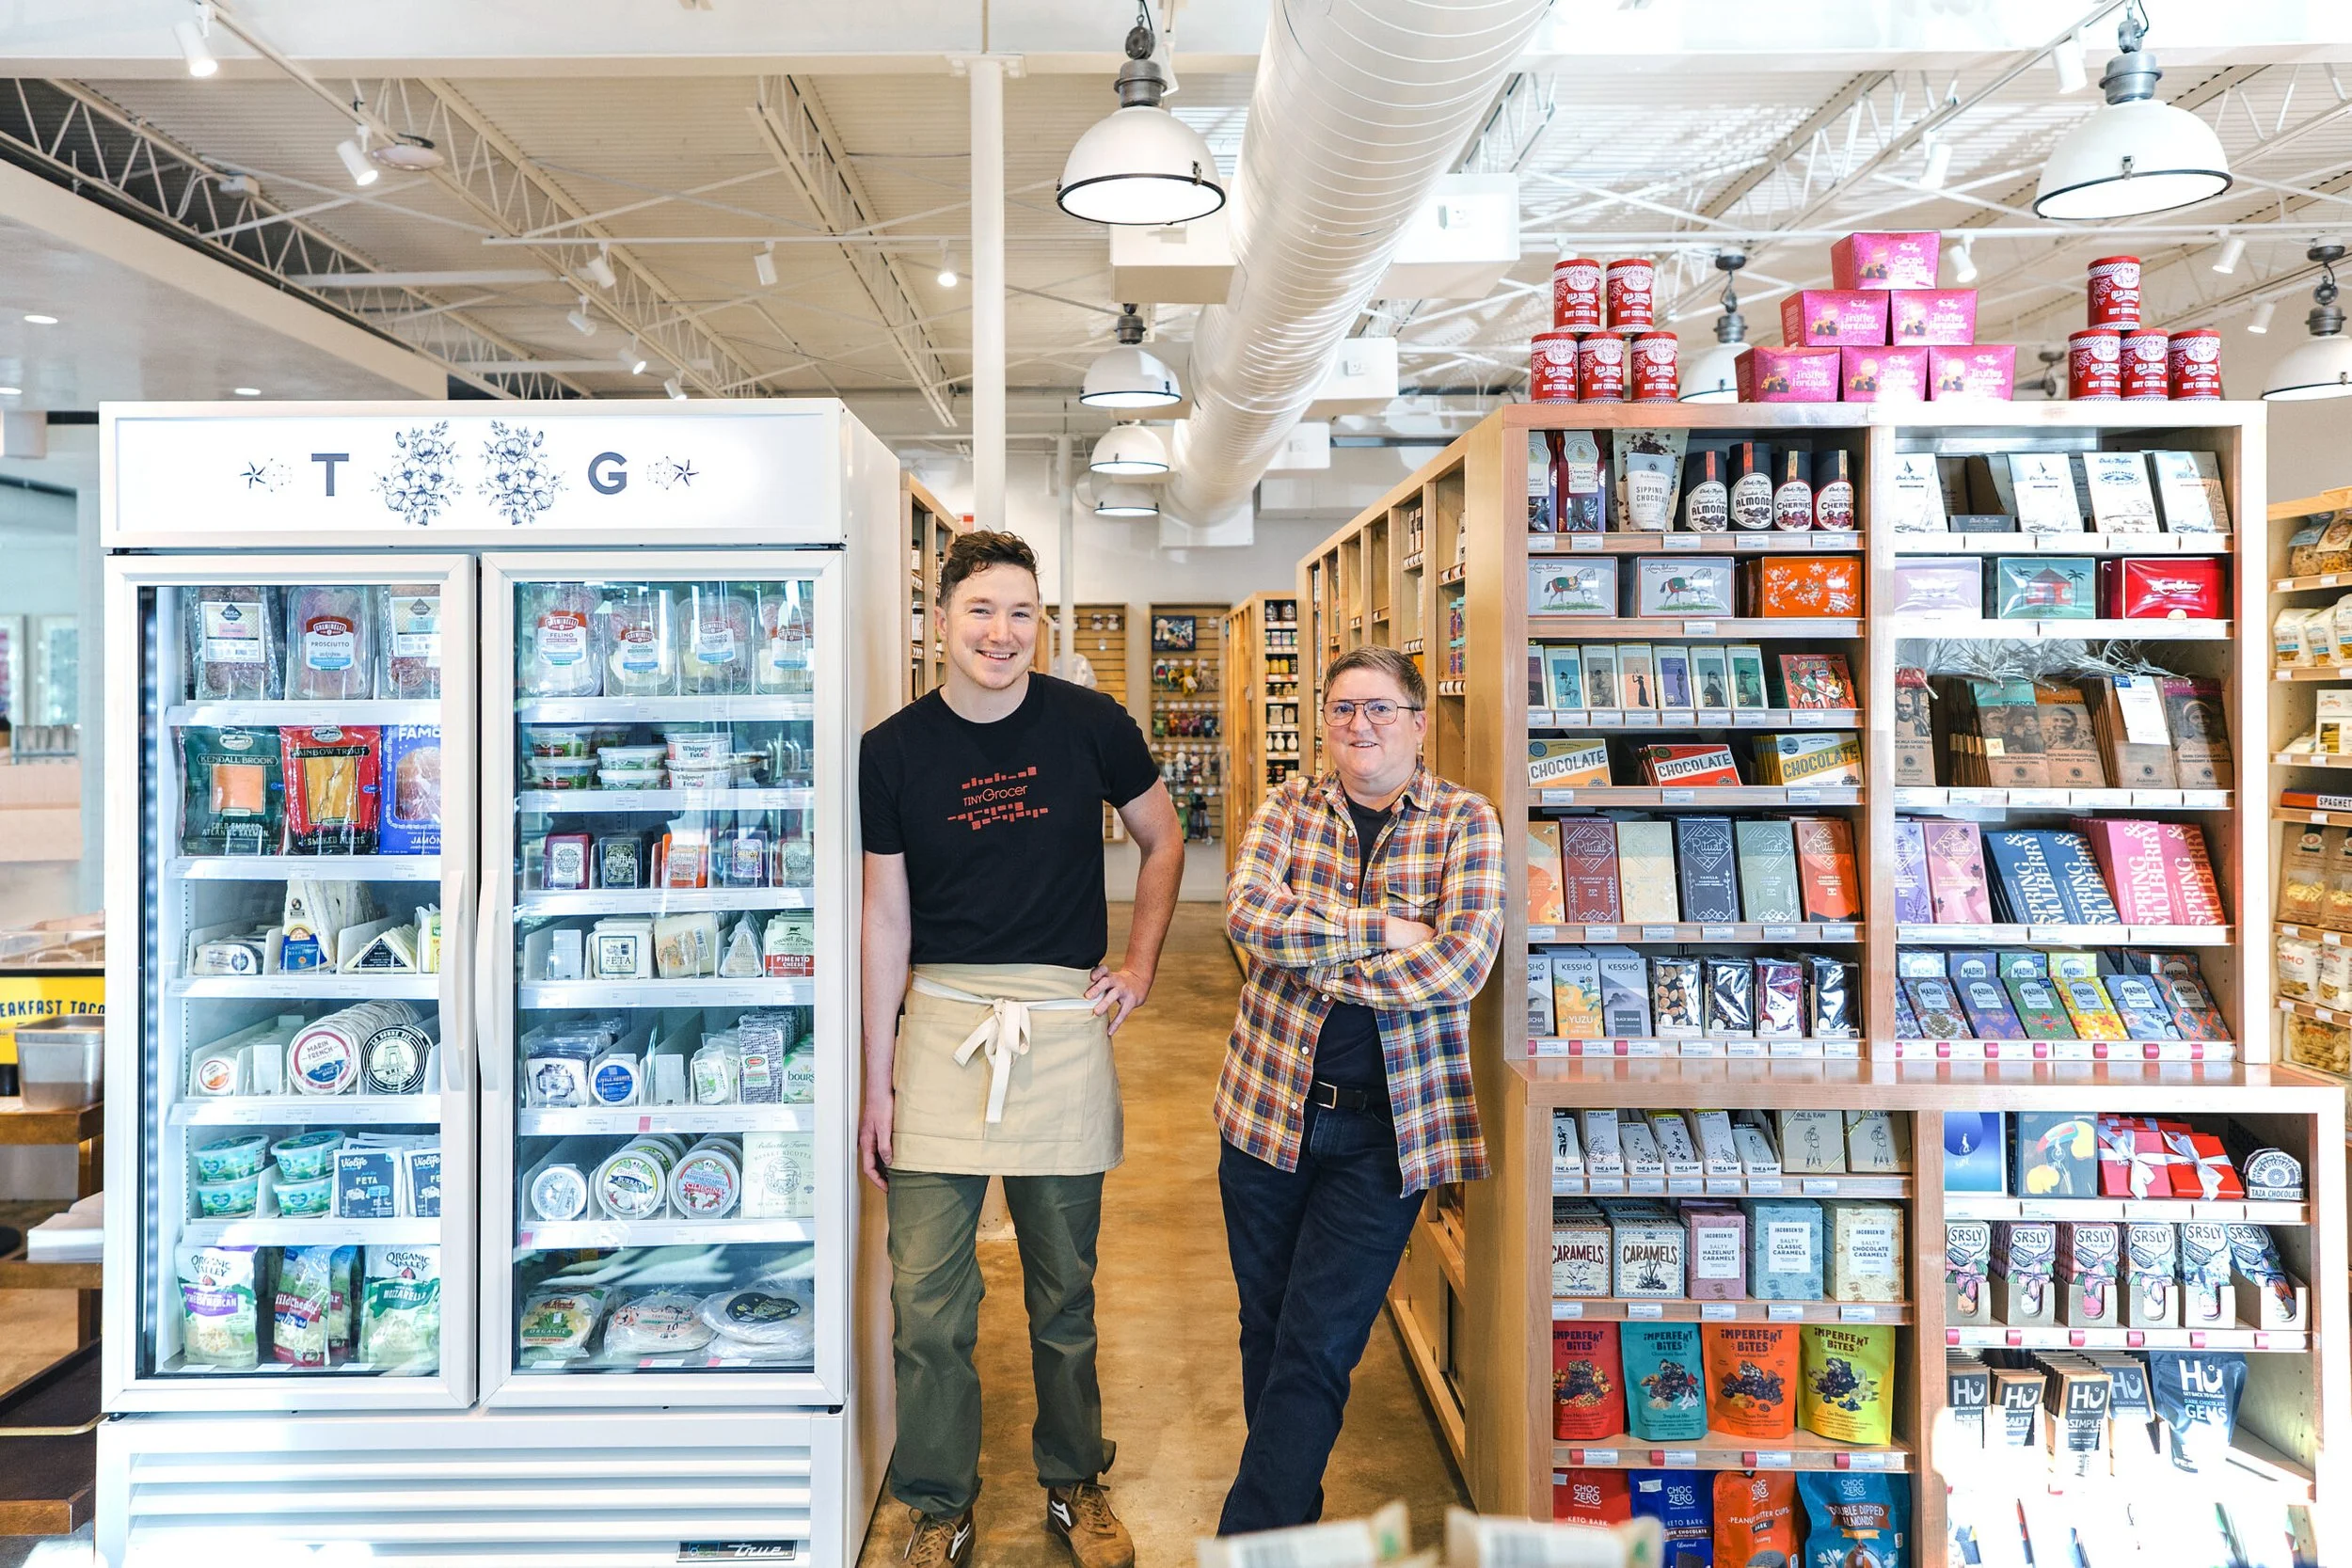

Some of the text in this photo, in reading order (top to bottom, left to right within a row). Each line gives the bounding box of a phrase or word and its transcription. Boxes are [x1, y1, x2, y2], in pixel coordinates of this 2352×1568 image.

[311, 451, 628, 497] T G
[200, 755, 274, 765] KENDALL BROOK
[1530, 750, 1606, 780] CHOCOLATE
[1658, 752, 1732, 778] CHOCOLATE
[1783, 744, 1859, 779] CHOCOLATE
[2014, 862, 2051, 925] SPRING
[2064, 862, 2103, 925] SPRING
[2128, 855, 2154, 925] SPRING
[2174, 857, 2207, 925] SPRING
[1963, 967, 1984, 977] MADHU
[2013, 967, 2035, 977] MADHU
[2063, 967, 2084, 977] MADHU
[1920, 988, 1943, 998] MADHU
[1972, 988, 1994, 998] MADHU
[2022, 988, 2044, 998] MADHU
[2072, 988, 2096, 998] MADHU
[2122, 987, 2146, 996] MADHU
[2173, 986, 2198, 996] MADHU
[1569, 1015, 1593, 1024] YUZU
[307, 1040, 329, 1053] MARIN
[308, 1046, 334, 1060] FRENCH
[341, 1157, 368, 1170] Violife
[356, 1176, 378, 1185] FETA
[2250, 1189, 2303, 1198] TAZA CHOCOLATE
[1950, 1229, 1982, 1242] SRSLY
[2014, 1230, 2047, 1243] SRSLY
[2077, 1230, 2110, 1243] SRSLY
[2134, 1229, 2168, 1243] SRSLY
[2187, 1226, 2221, 1239] SRSLY
[2229, 1227, 2265, 1240] SRSLY
[386, 1251, 431, 1267] ORGANIC
[1552, 1244, 1604, 1264] CARAMELS
[1623, 1244, 1677, 1265] CARAMELS
[2185, 1404, 2228, 1422] GEMS
[2068, 1418, 2101, 1429] SIMPLE
[1841, 1479, 1864, 1487] CHOC
[1573, 1484, 1600, 1494] CHOC
[1667, 1486, 1692, 1495] CHOC
[1843, 1486, 1867, 1496] ZERO
[1573, 1494, 1601, 1505] ZERO
[1668, 1494, 1695, 1505] ZERO
[1774, 1507, 1789, 1515] CUPS
[1830, 1505, 1884, 1516] DOUBLE DIPPED
[1588, 1518, 1608, 1527] BARK
[1843, 1515, 1873, 1527] ALMONDS
